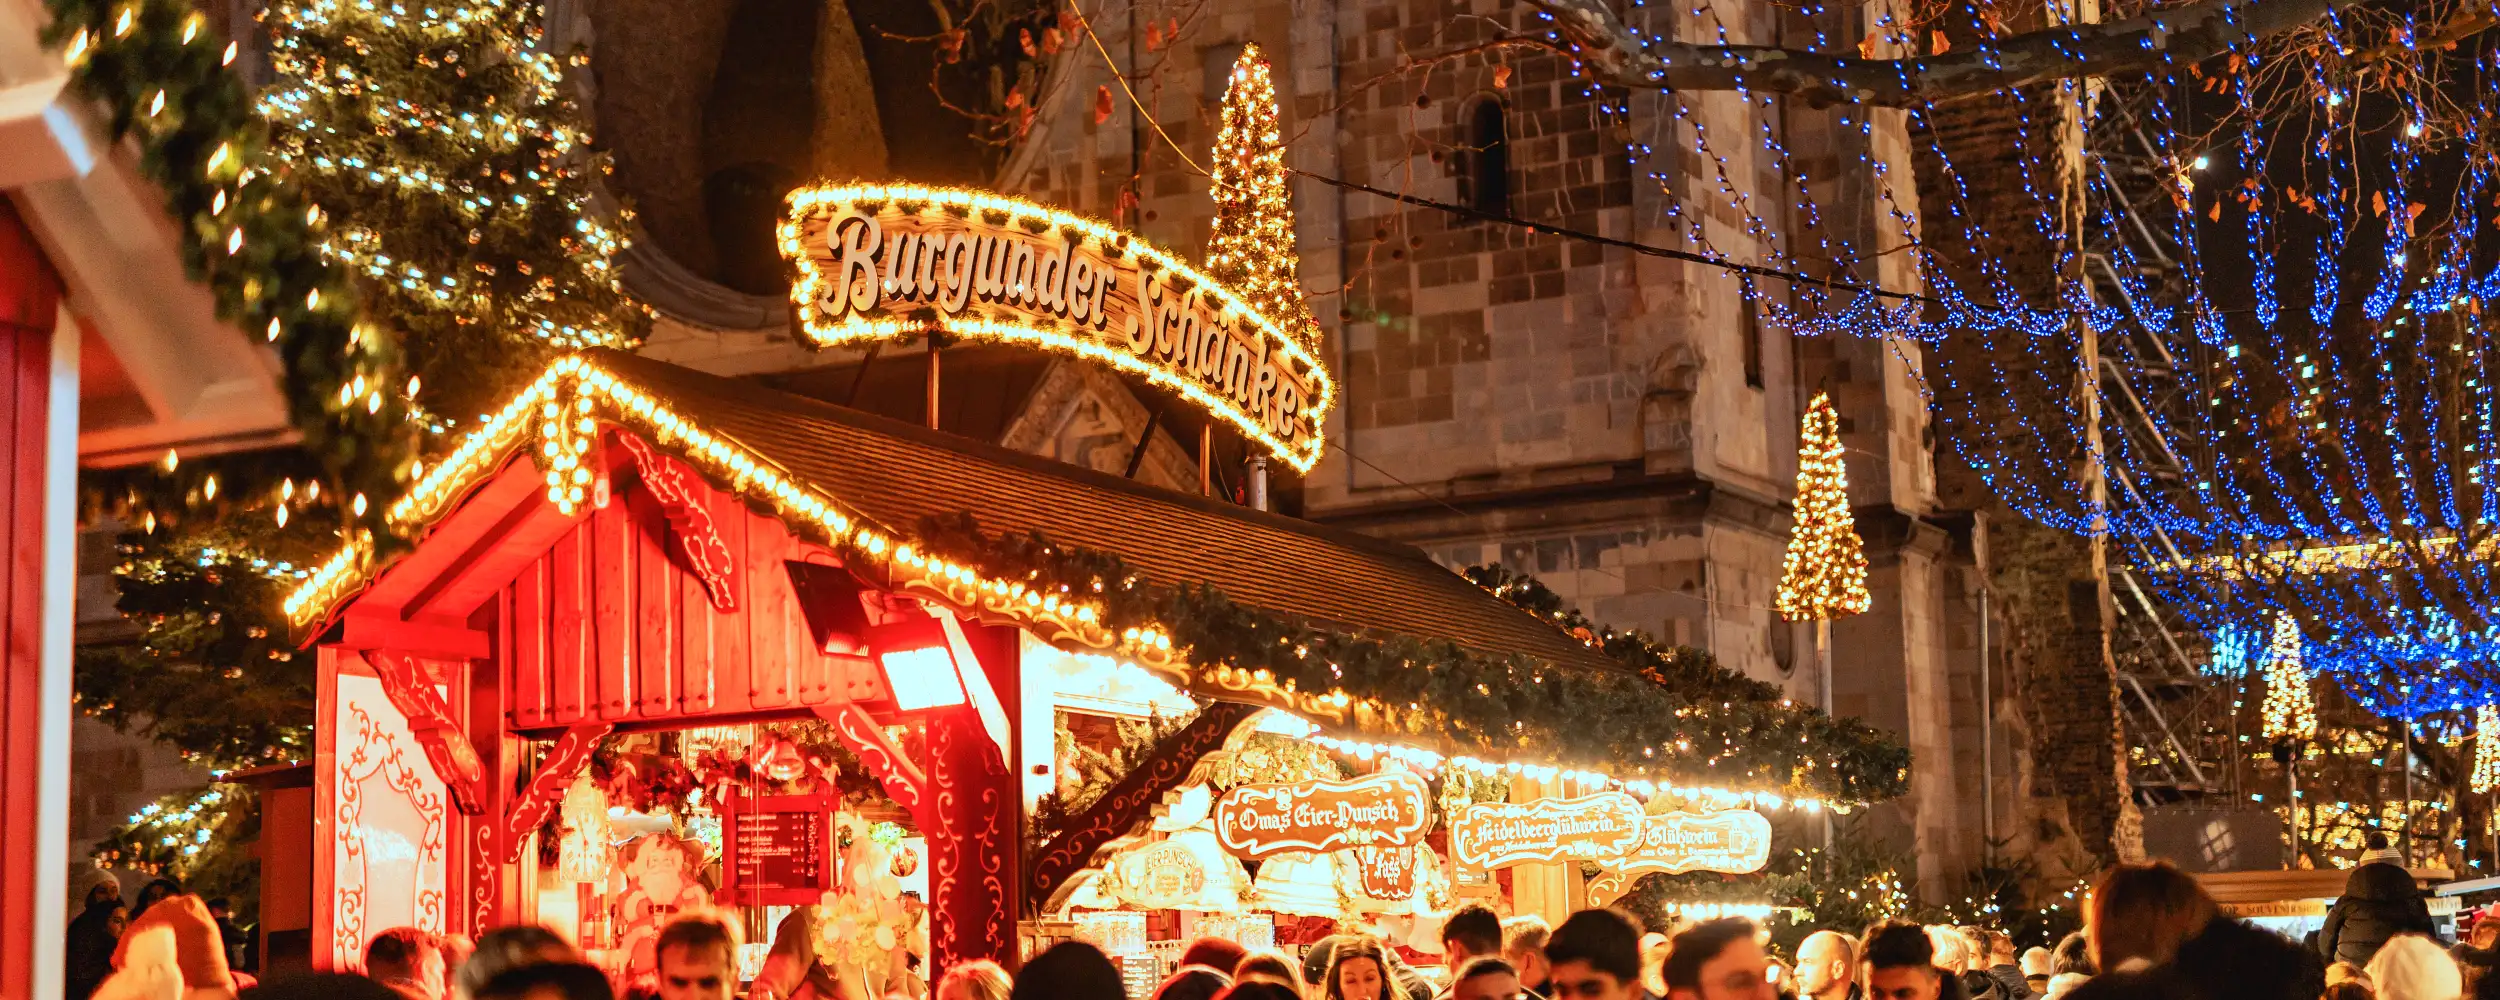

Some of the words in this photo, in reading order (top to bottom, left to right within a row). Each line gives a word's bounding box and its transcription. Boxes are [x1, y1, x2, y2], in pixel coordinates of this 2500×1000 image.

[819, 215, 1117, 327] Burgunder
[1126, 267, 1299, 438] Schänke
[1239, 808, 1291, 832] Omas
[1294, 798, 1400, 829] Eier-Punsch
[1475, 815, 1617, 845] Heidelbeerglühwein
[1646, 825, 1718, 848] Glühwein
